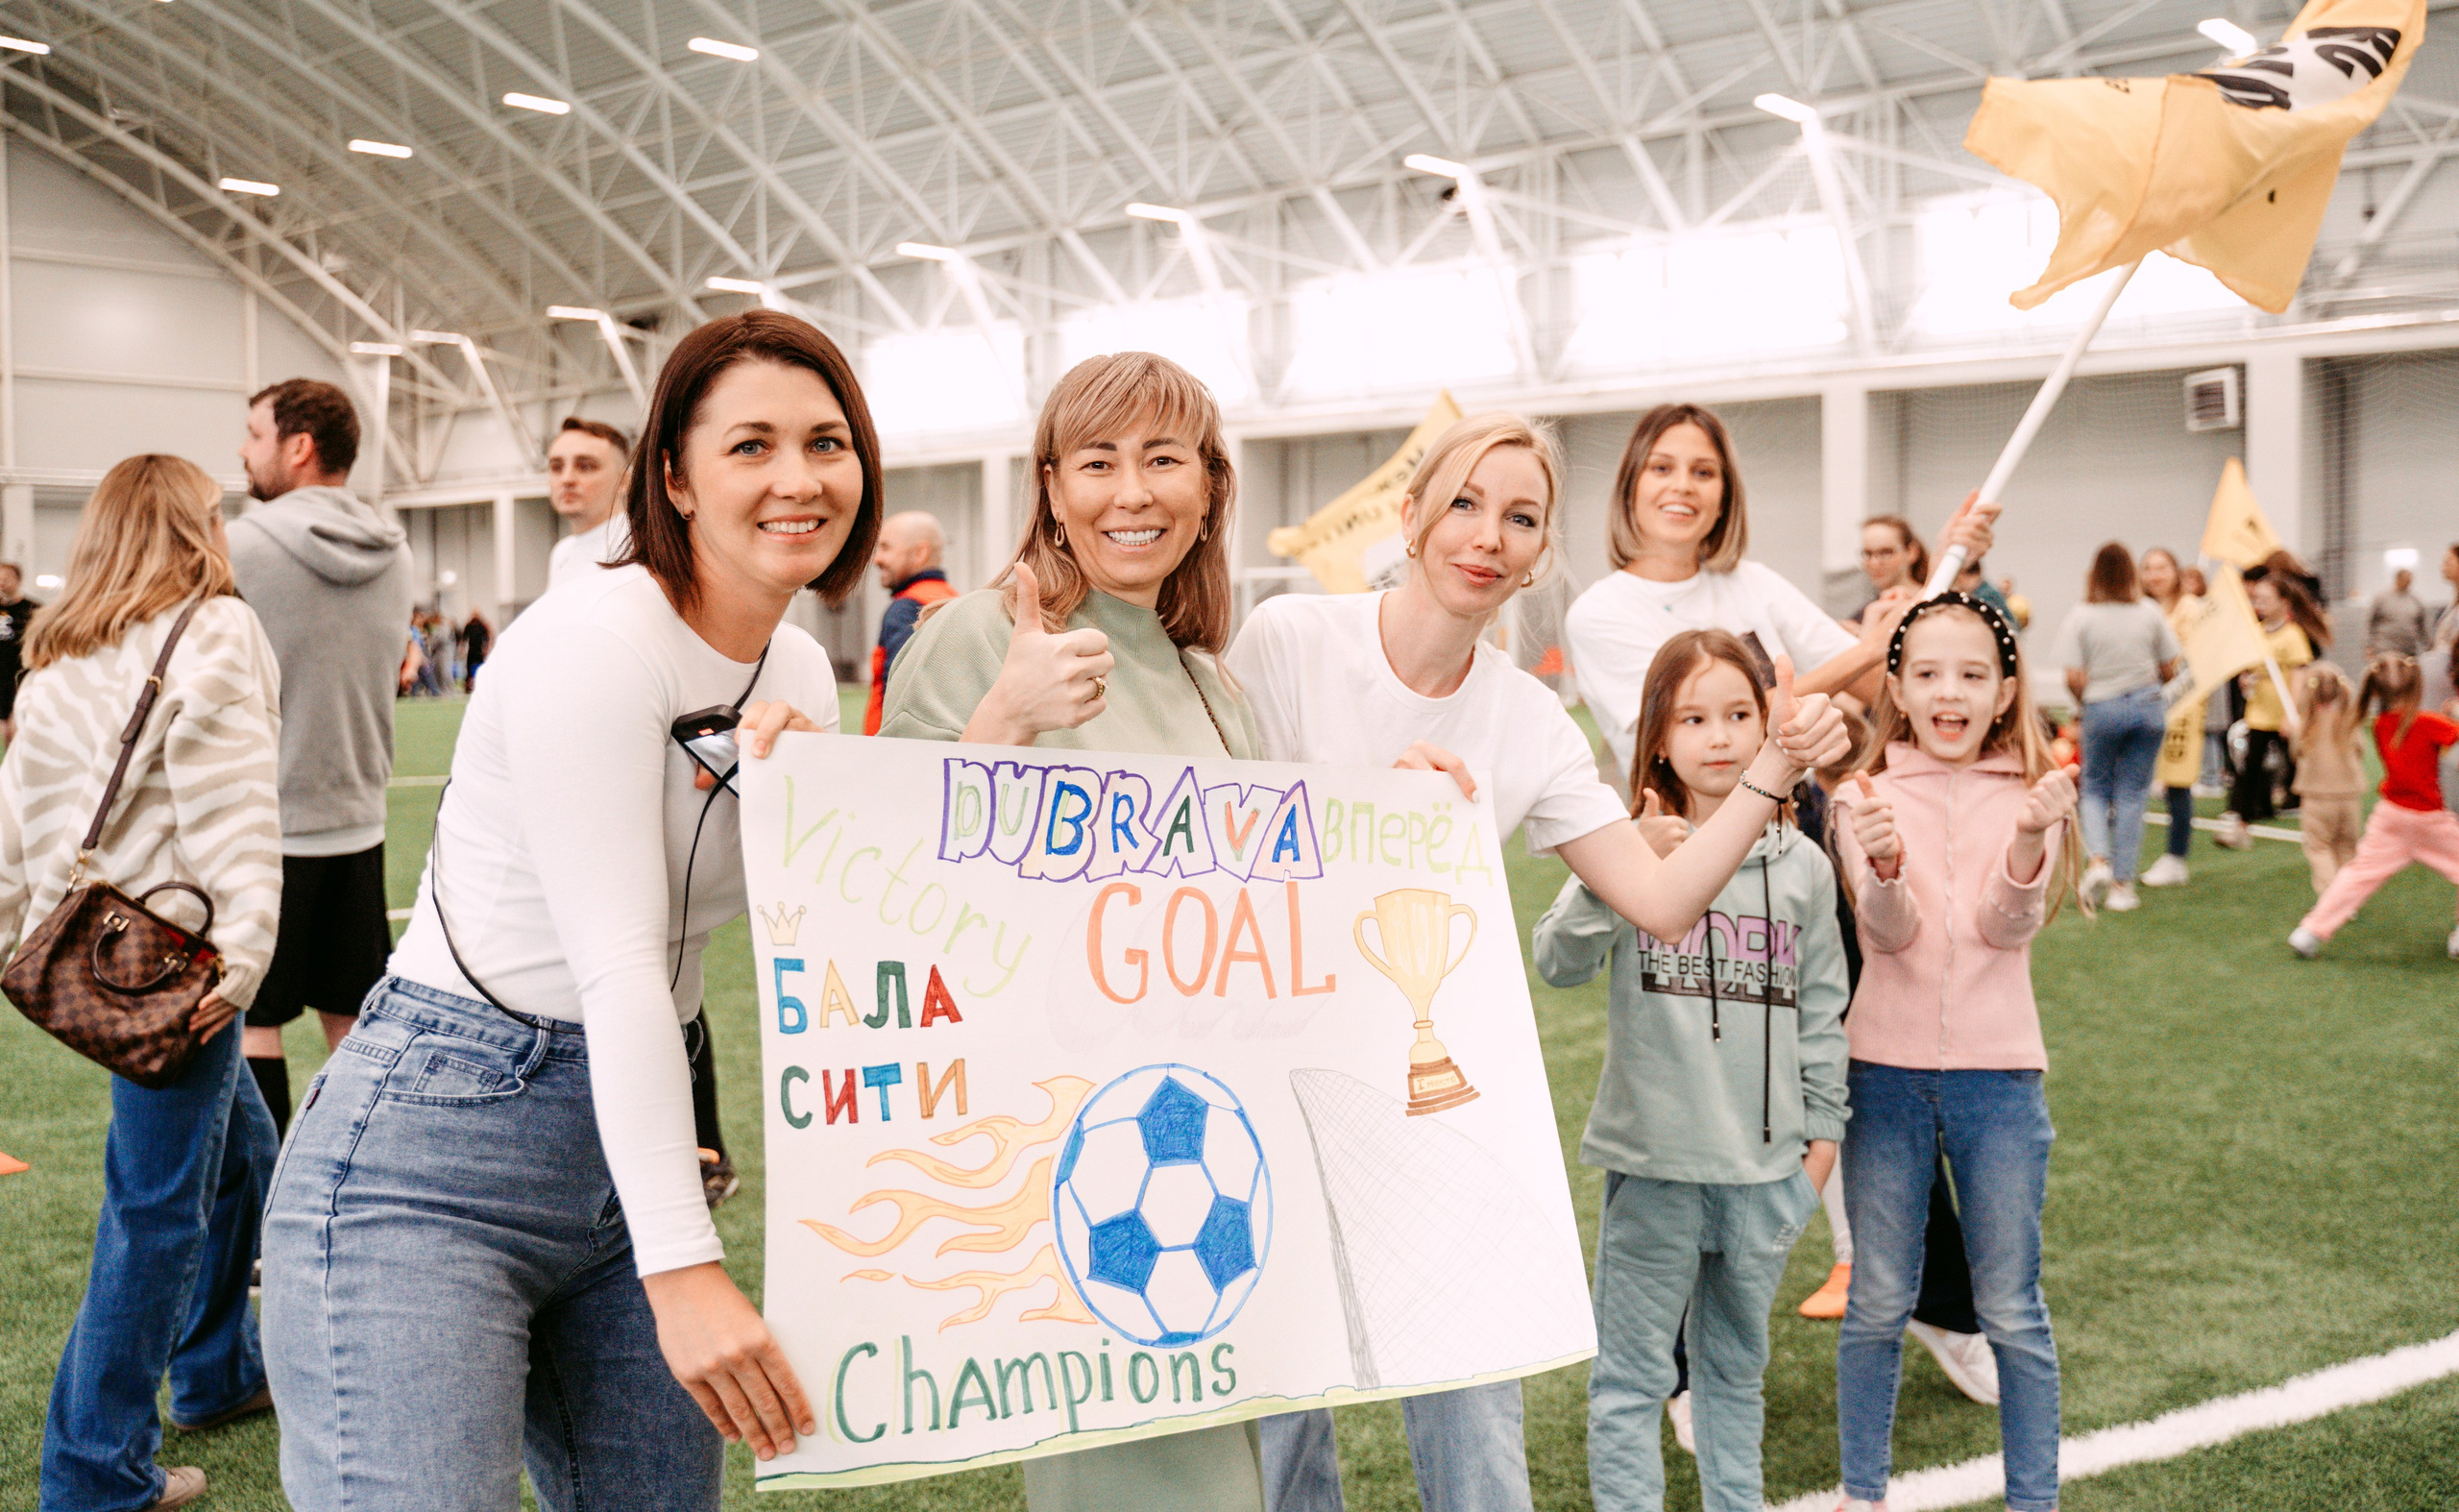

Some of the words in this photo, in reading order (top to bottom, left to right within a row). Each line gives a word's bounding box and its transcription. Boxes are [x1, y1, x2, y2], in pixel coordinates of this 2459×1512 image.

[937, 758, 1324, 883] DUBRAVA
[774, 774, 1033, 998] Victory
[1086, 881, 1336, 1004] GOAL
[1638, 950, 1670, 974] THE
[1678, 955, 1728, 978] BEST
[1734, 961, 1798, 988] FASHION
[773, 957, 963, 1035] БАЛА
[781, 1058, 967, 1130] СИТИ
